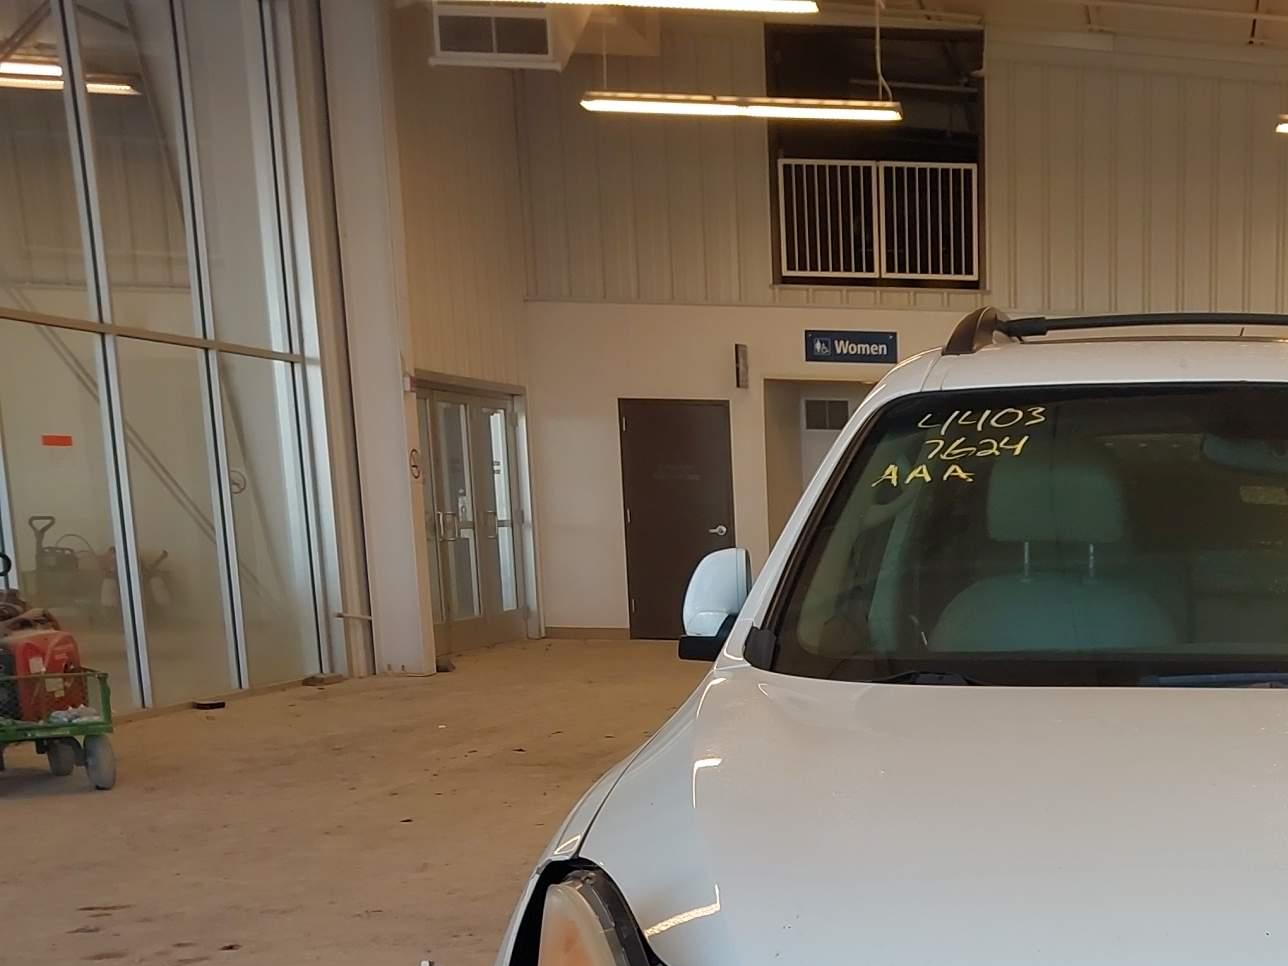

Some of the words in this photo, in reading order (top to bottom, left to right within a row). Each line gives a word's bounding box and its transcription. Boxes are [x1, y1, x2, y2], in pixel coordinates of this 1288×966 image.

[833, 339, 888, 356] Women
[917, 406, 1046, 436] 4403
[924, 435, 1030, 460] 7624
